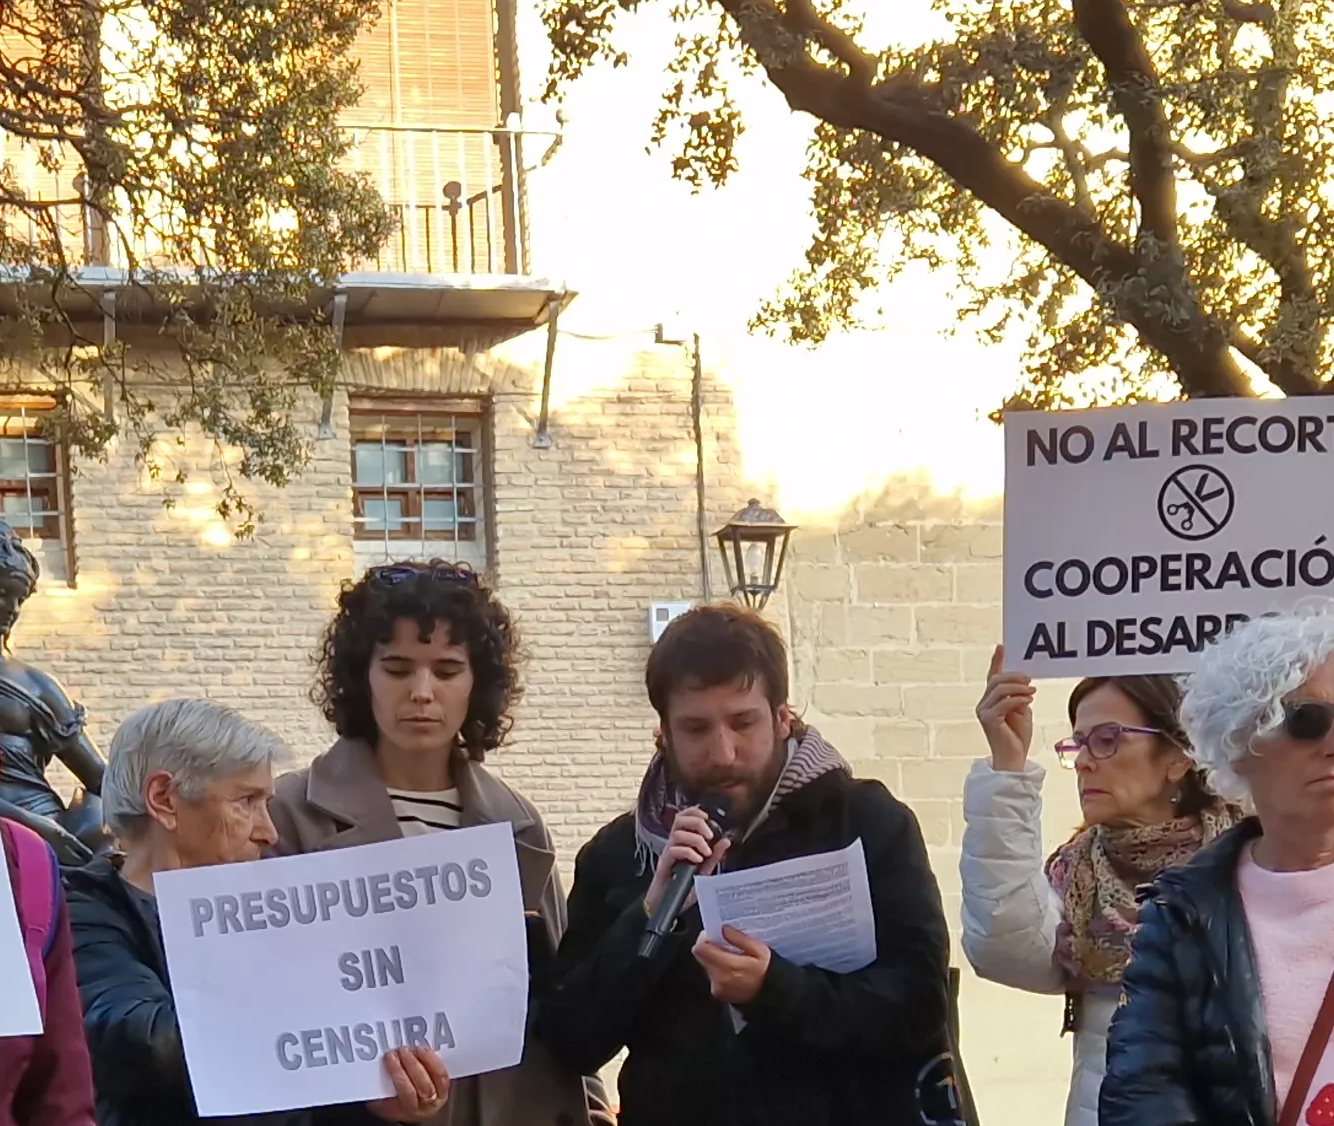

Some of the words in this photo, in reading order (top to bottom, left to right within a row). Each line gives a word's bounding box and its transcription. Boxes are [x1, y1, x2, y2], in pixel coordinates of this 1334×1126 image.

[1026, 427, 1094, 467] NO
[1103, 421, 1159, 460] AL
[1023, 621, 1077, 660] AL
[188, 858, 492, 937] PRESUPUESTOS
[337, 945, 405, 992] SIN
[275, 1011, 456, 1071] CENSURA
